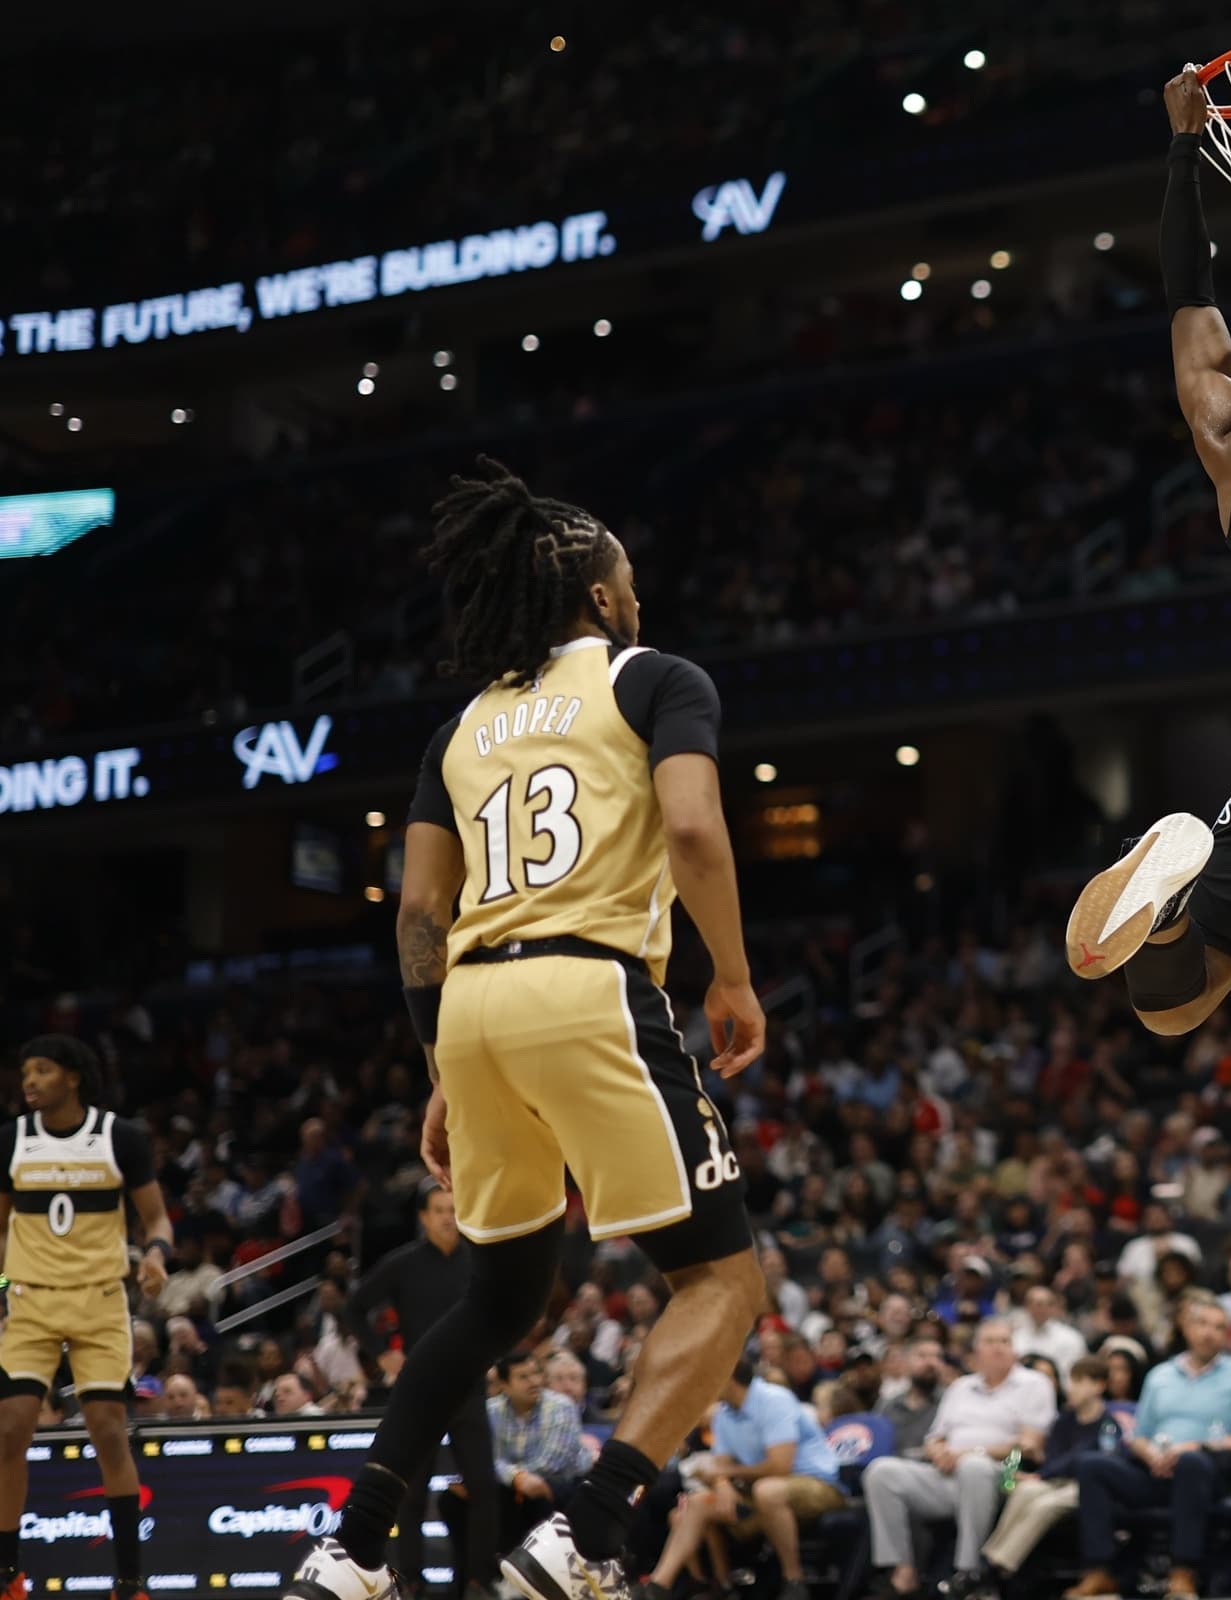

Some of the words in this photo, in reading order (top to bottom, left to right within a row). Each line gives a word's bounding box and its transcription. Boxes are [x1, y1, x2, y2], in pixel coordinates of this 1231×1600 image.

[10, 307, 96, 354] THE
[102, 282, 253, 348] FUTURE,
[256, 255, 377, 319] WE'RE
[381, 220, 560, 296] BUILDING
[561, 210, 617, 263] IT.
[474, 695, 582, 758] COOPER
[93, 747, 150, 801] IT.
[473, 763, 583, 905] 13
[48, 1192, 75, 1237] 0
